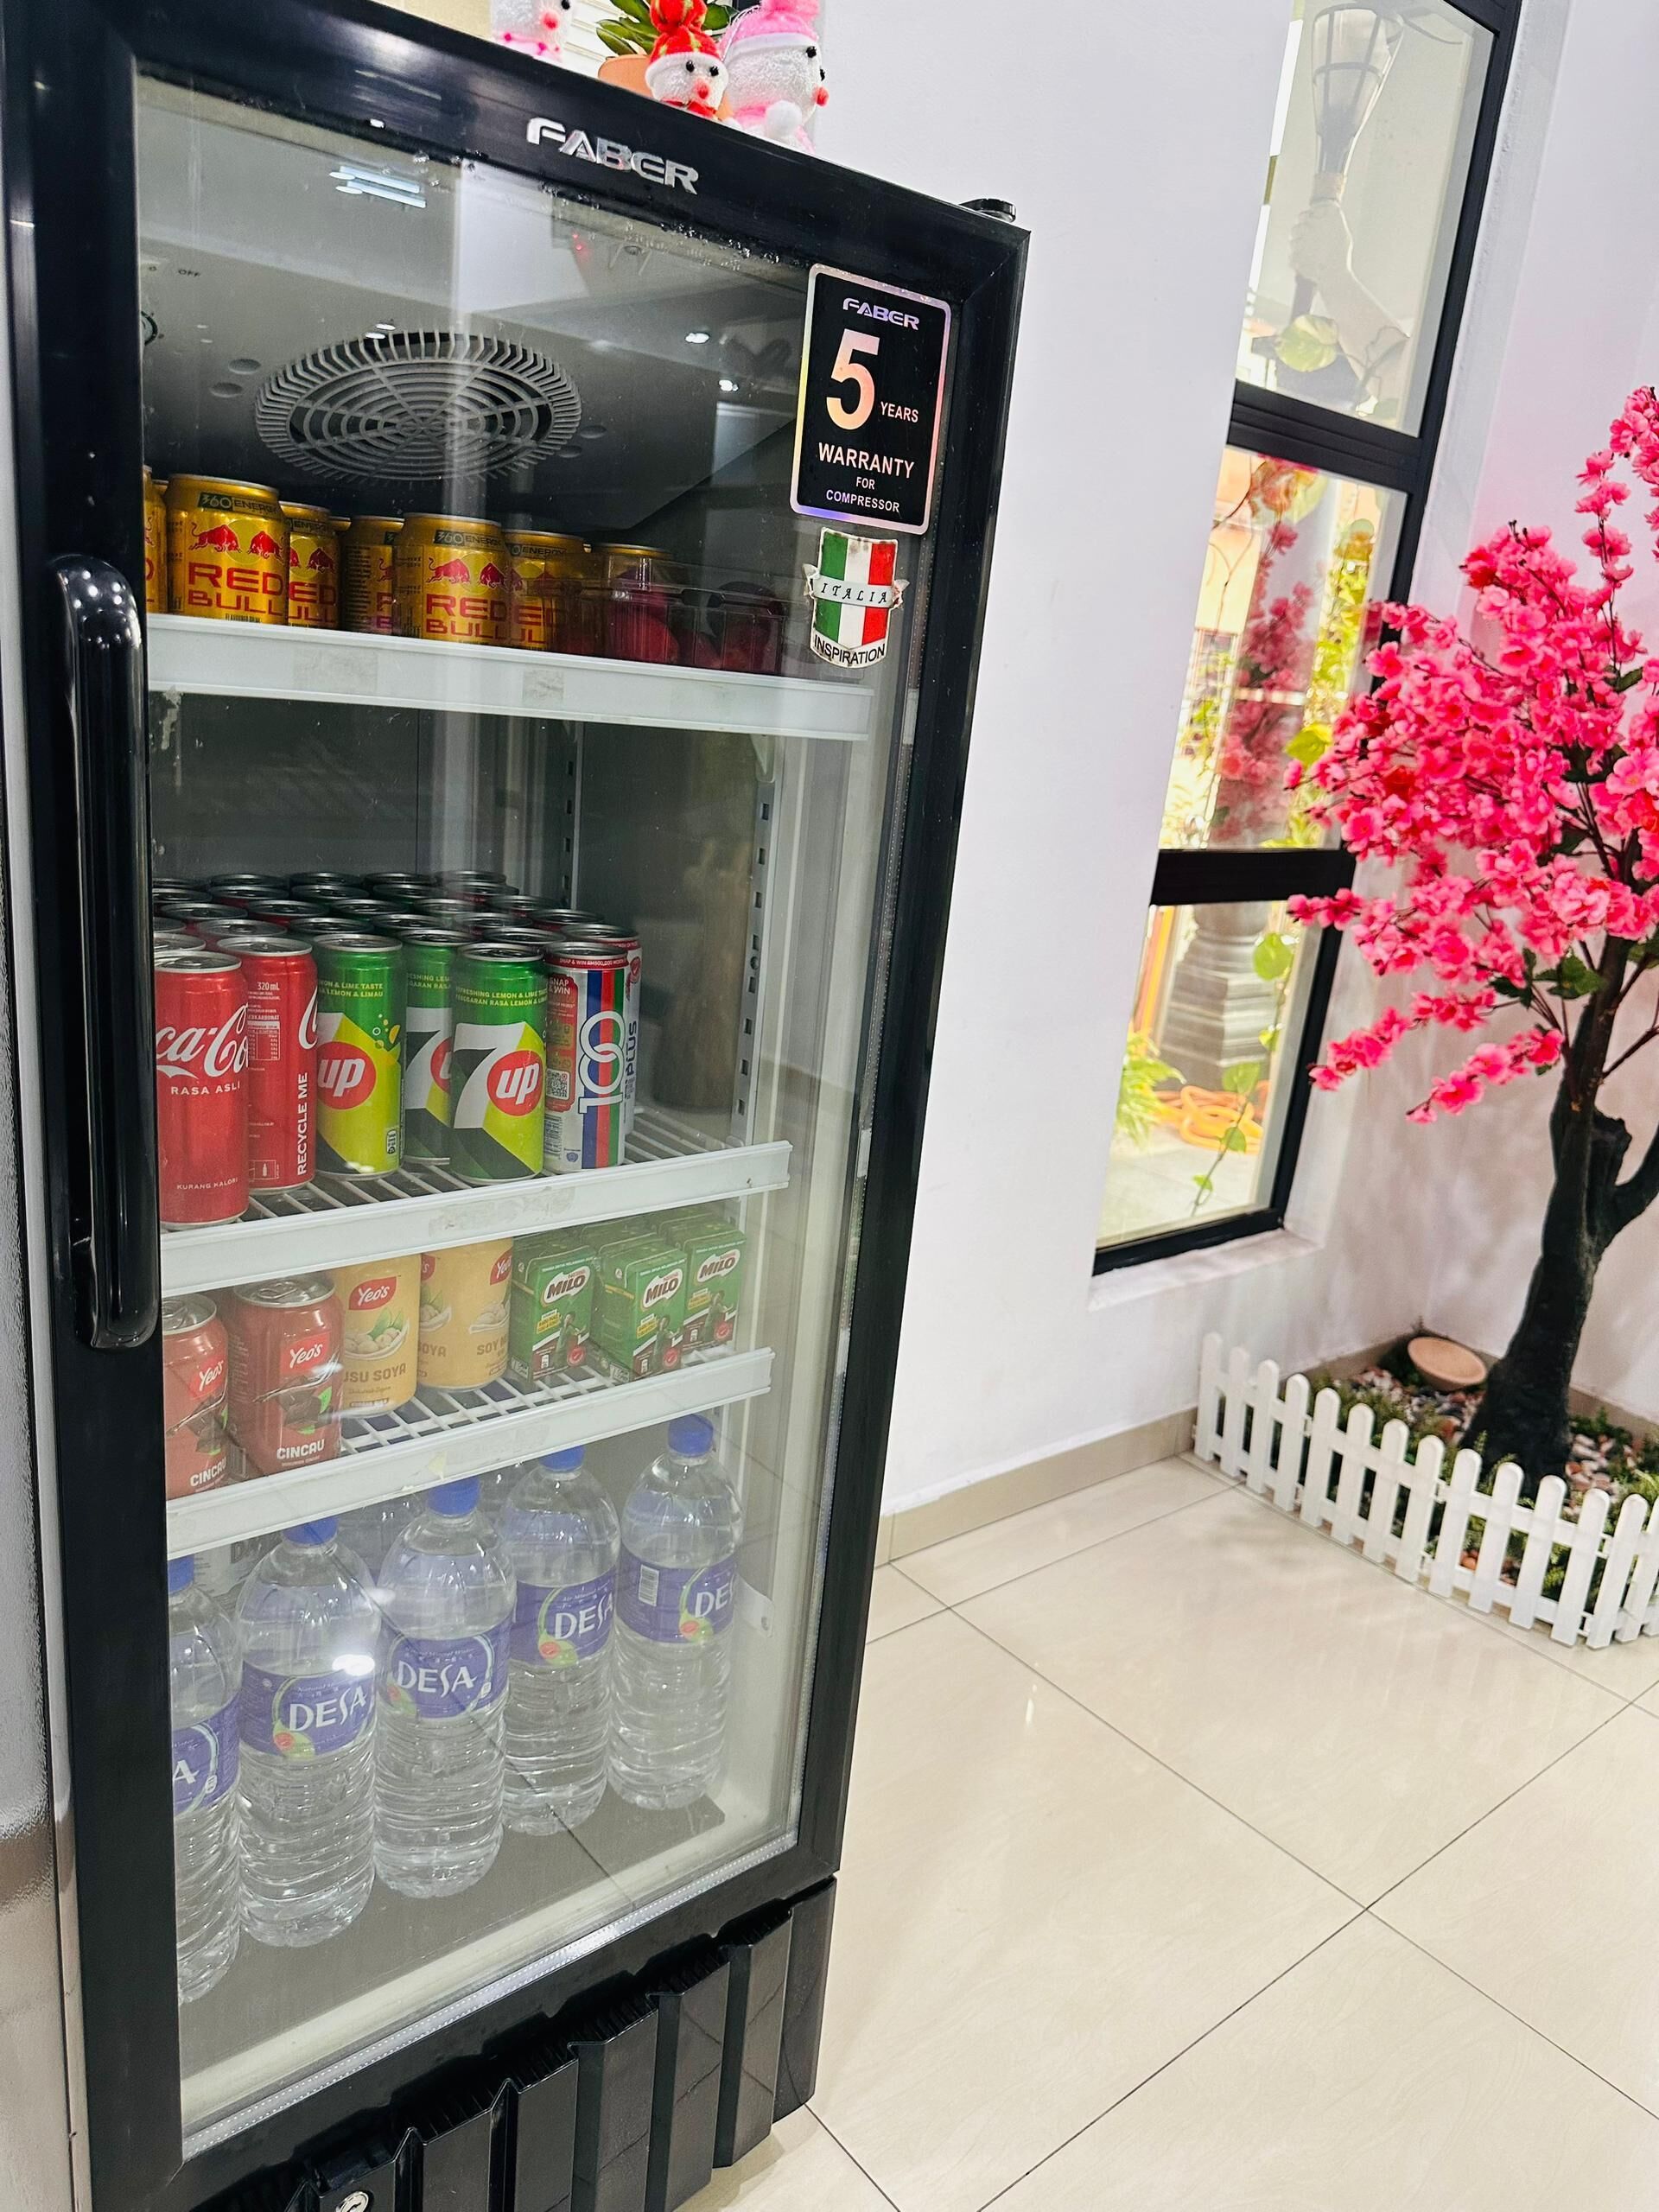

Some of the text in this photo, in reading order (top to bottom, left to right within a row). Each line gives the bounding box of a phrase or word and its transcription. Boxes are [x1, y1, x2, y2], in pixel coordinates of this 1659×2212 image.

[526, 117, 699, 195] FABER
[842, 297, 920, 330] FABER
[826, 328, 919, 430] 5 YEARS
[818, 442, 914, 479] WARRANTY
[855, 476, 875, 490] FOR
[826, 489, 900, 512] COMPRESSOR
[188, 562, 284, 597] RED
[188, 589, 284, 617] BULL
[289, 581, 337, 607] ED
[821, 582, 888, 605] ITALIA
[426, 594, 508, 622] RED
[426, 619, 511, 640] BULL
[814, 634, 886, 664] INSPIRATION
[554, 985, 571, 995] WIN
[156, 1002, 249, 1077] ca-Co
[171, 1081, 240, 1096] RASA ASLI
[297, 1072, 308, 1176] RECYCLE ME
[698, 1255, 735, 1279] MILO
[358, 1284, 391, 1306] Yeo's
[546, 1274, 586, 1300] MILO
[645, 1278, 679, 1304] MILO
[289, 1343, 323, 1369] Yeo's
[419, 1342, 447, 1357] OYA
[199, 1359, 224, 1391] Yeo's
[372, 1362, 406, 1382] SOYA
[276, 1438, 325, 1460] CINCAU
[189, 1456, 227, 1487] CINCAU
[695, 1573, 734, 1618] DES
[397, 1660, 478, 1699] DESA
[289, 1686, 368, 1732] DESA
